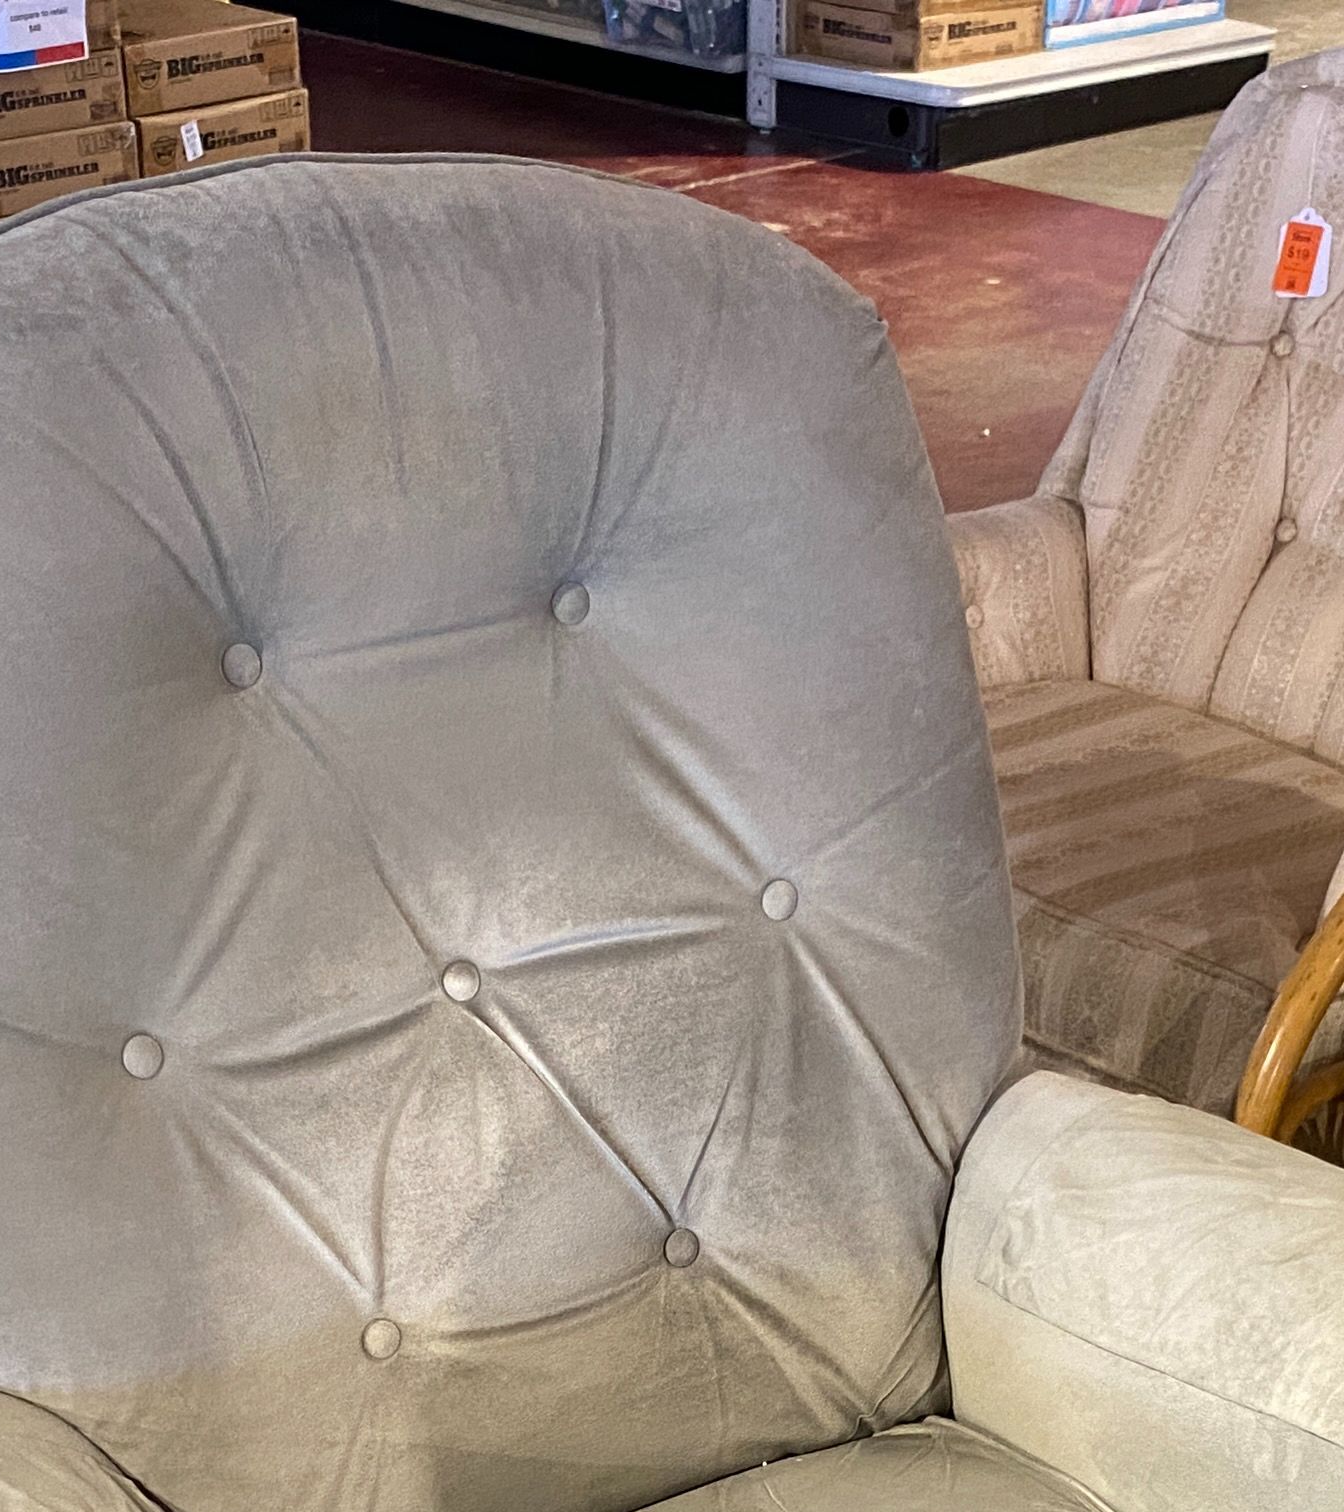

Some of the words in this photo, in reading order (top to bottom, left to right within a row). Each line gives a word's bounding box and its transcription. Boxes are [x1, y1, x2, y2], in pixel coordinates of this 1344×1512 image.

[167, 54, 200, 79] BIG
[16, 88, 87, 109] SPRINKLER
[29, 162, 99, 183] SPRINKLER
